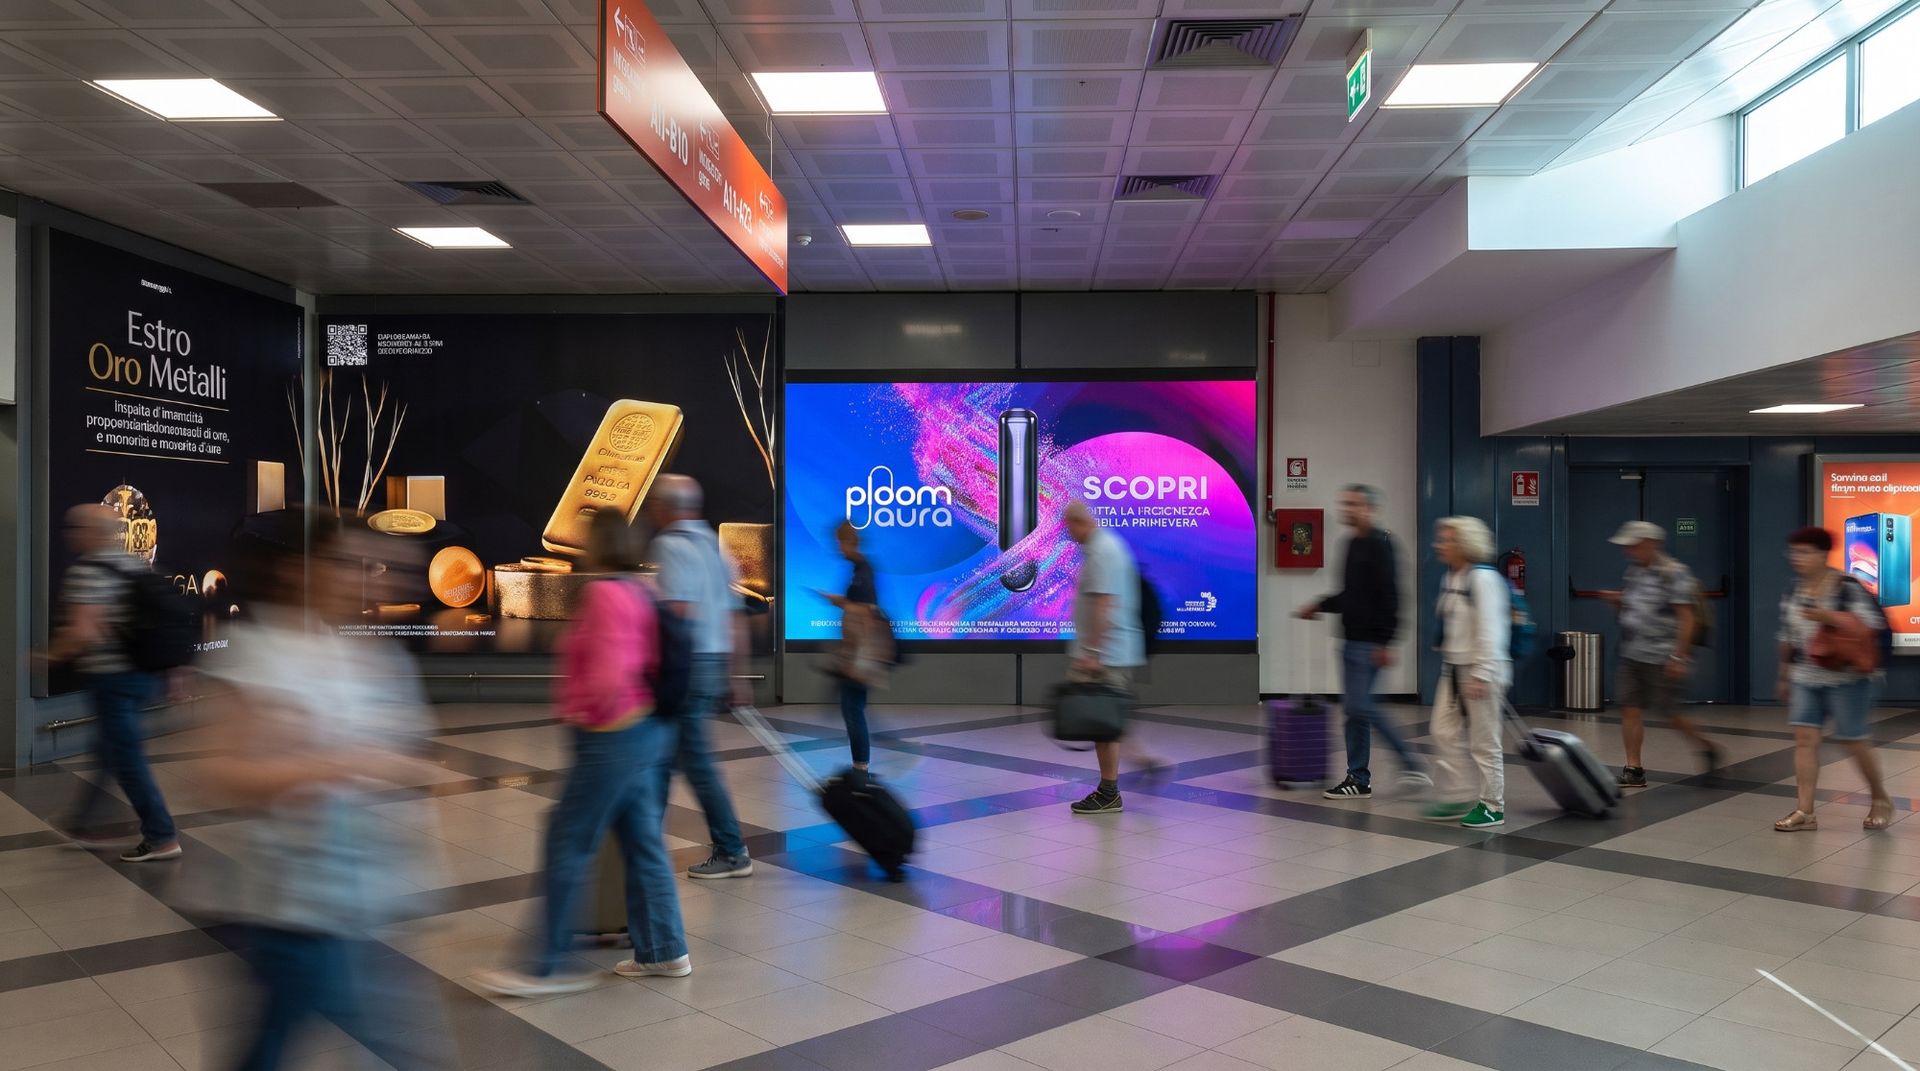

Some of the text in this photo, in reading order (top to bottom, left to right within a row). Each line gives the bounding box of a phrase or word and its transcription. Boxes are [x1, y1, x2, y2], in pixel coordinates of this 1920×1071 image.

[128, 310, 191, 356] Estro
[88, 342, 226, 400] Oro Metalli
[846, 465, 952, 530] ploom
[1083, 475, 1208, 500] SCOPRI
[873, 507, 953, 527] aura
[1120, 506, 1135, 516] LA
